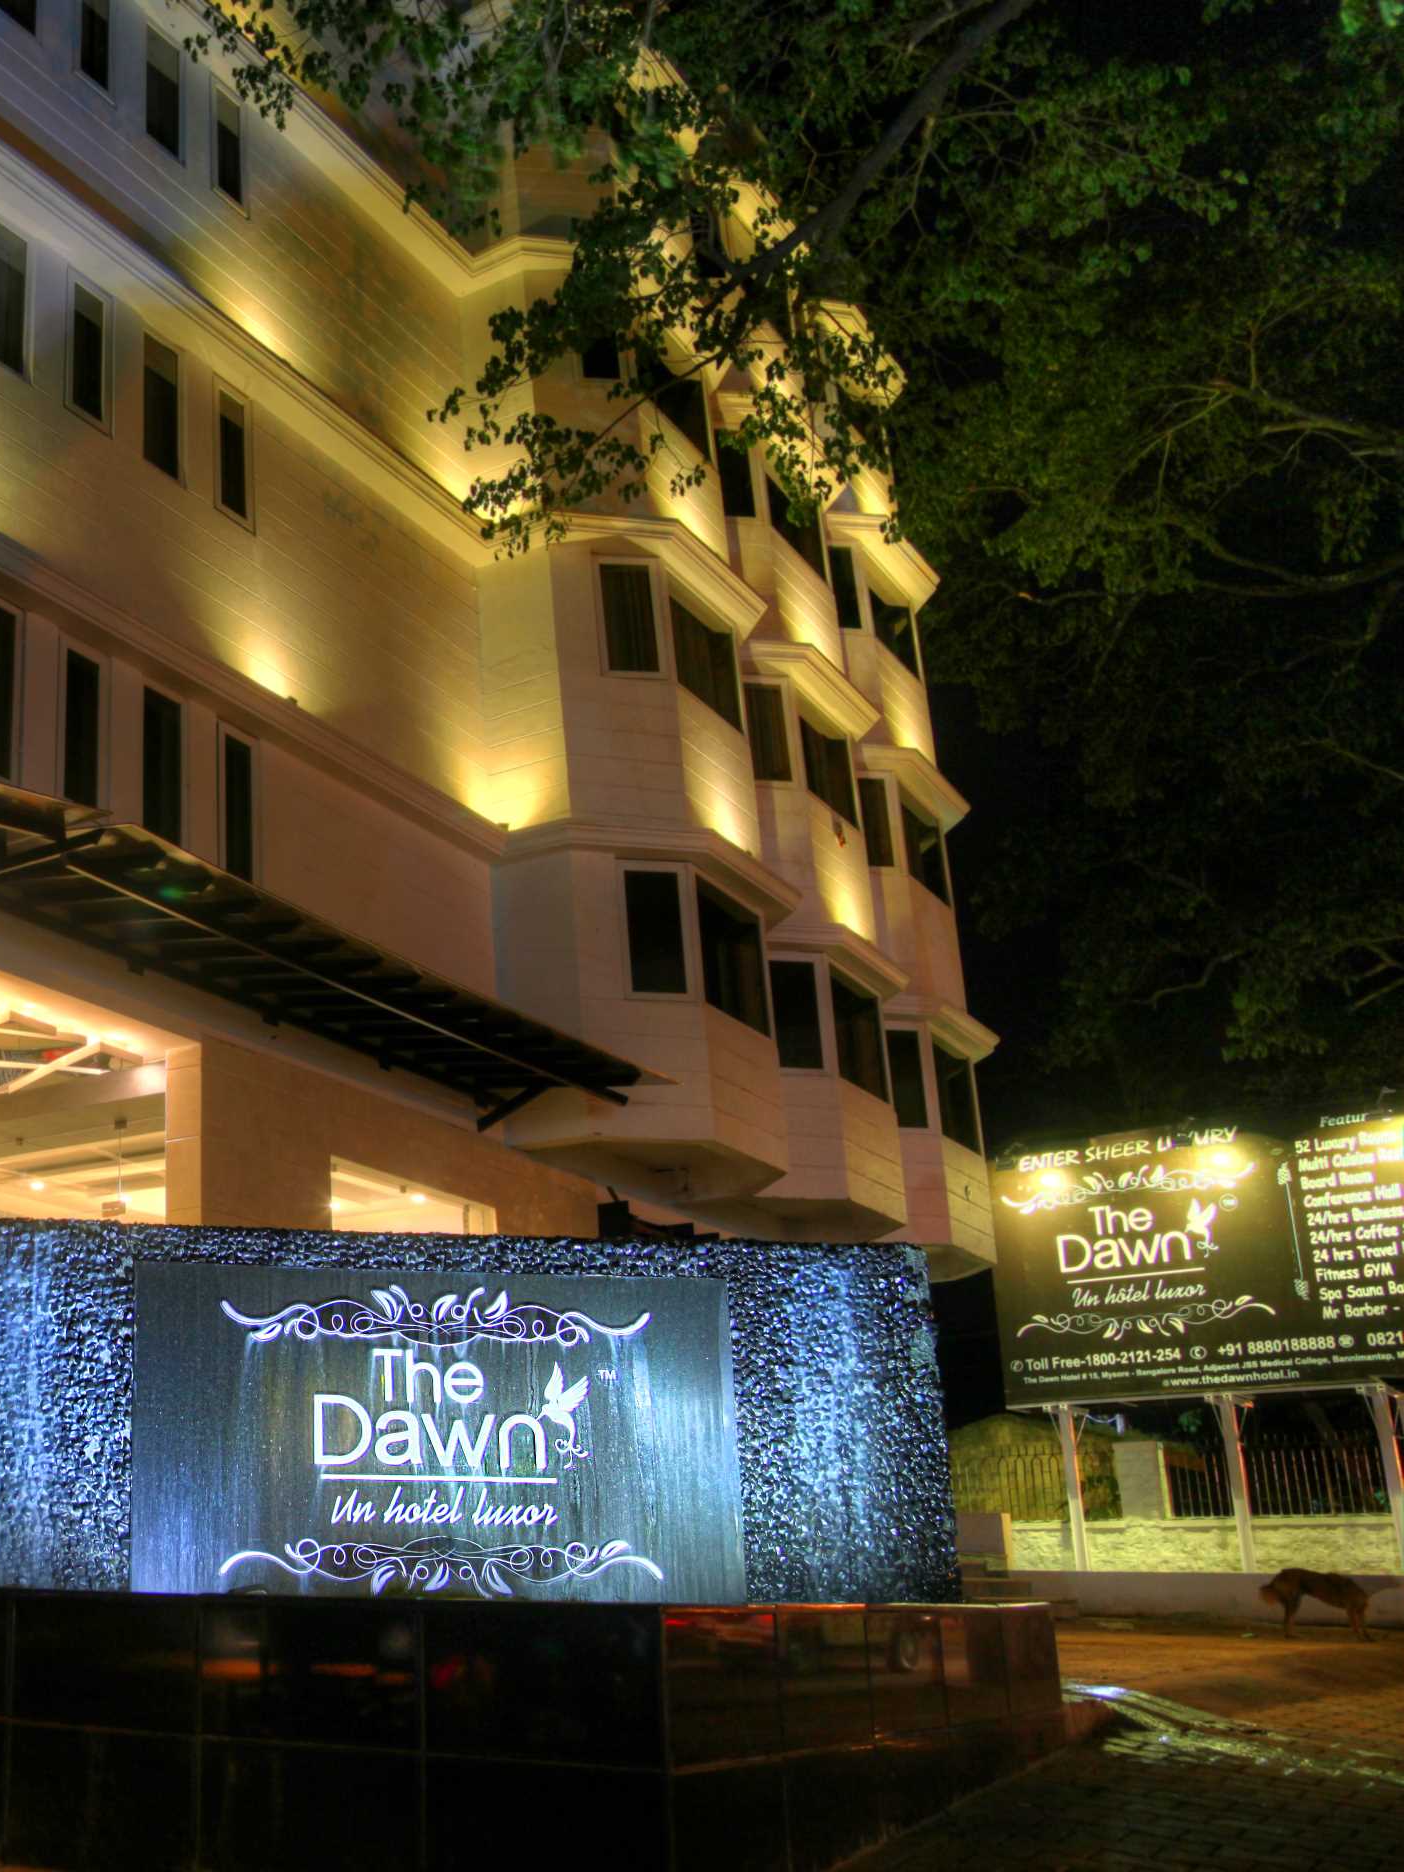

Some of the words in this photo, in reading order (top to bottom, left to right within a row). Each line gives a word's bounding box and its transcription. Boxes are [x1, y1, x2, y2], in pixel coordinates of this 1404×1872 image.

[1018, 1150, 1081, 1172] ENTER
[1085, 1139, 1152, 1163] SHEER
[1294, 1139, 1311, 1154] 52
[1298, 1155, 1330, 1172] Multi
[1300, 1172, 1337, 1190] Board
[1303, 1191, 1373, 1208] Conference
[1374, 1183, 1401, 1200] Hall
[1087, 1204, 1155, 1236] The
[1306, 1210, 1349, 1226] 24/hrs
[1309, 1229, 1352, 1244] 24/hrs
[1355, 1223, 1399, 1240] Coffee
[1056, 1231, 1192, 1274] Dawn
[1312, 1249, 1330, 1263] 24
[1332, 1247, 1355, 1262] hrs
[1356, 1241, 1399, 1259] Travel
[1315, 1268, 1360, 1283] Fitness
[1363, 1262, 1395, 1278] GYM
[1071, 1286, 1101, 1308] Un
[1104, 1280, 1151, 1305] hôtel
[1154, 1279, 1207, 1301] luxor
[1319, 1287, 1343, 1304] Spa
[1346, 1285, 1384, 1299] Sauna
[1322, 1306, 1340, 1320] Mr
[1343, 1302, 1388, 1318] Barber
[1217, 1342, 1244, 1357] +91
[1247, 1335, 1336, 1355] 8880188888
[1025, 1356, 1049, 1372] Toll
[1259, 1359, 1294, 1369] Medical
[372, 1348, 486, 1404] The
[598, 1369, 617, 1381] TM
[1169, 1369, 1300, 1386] www.thedawnhotel.in
[313, 1394, 549, 1470] Dawn
[330, 1488, 377, 1525] Un
[383, 1486, 467, 1525] hotel
[471, 1487, 559, 1526] luxor
